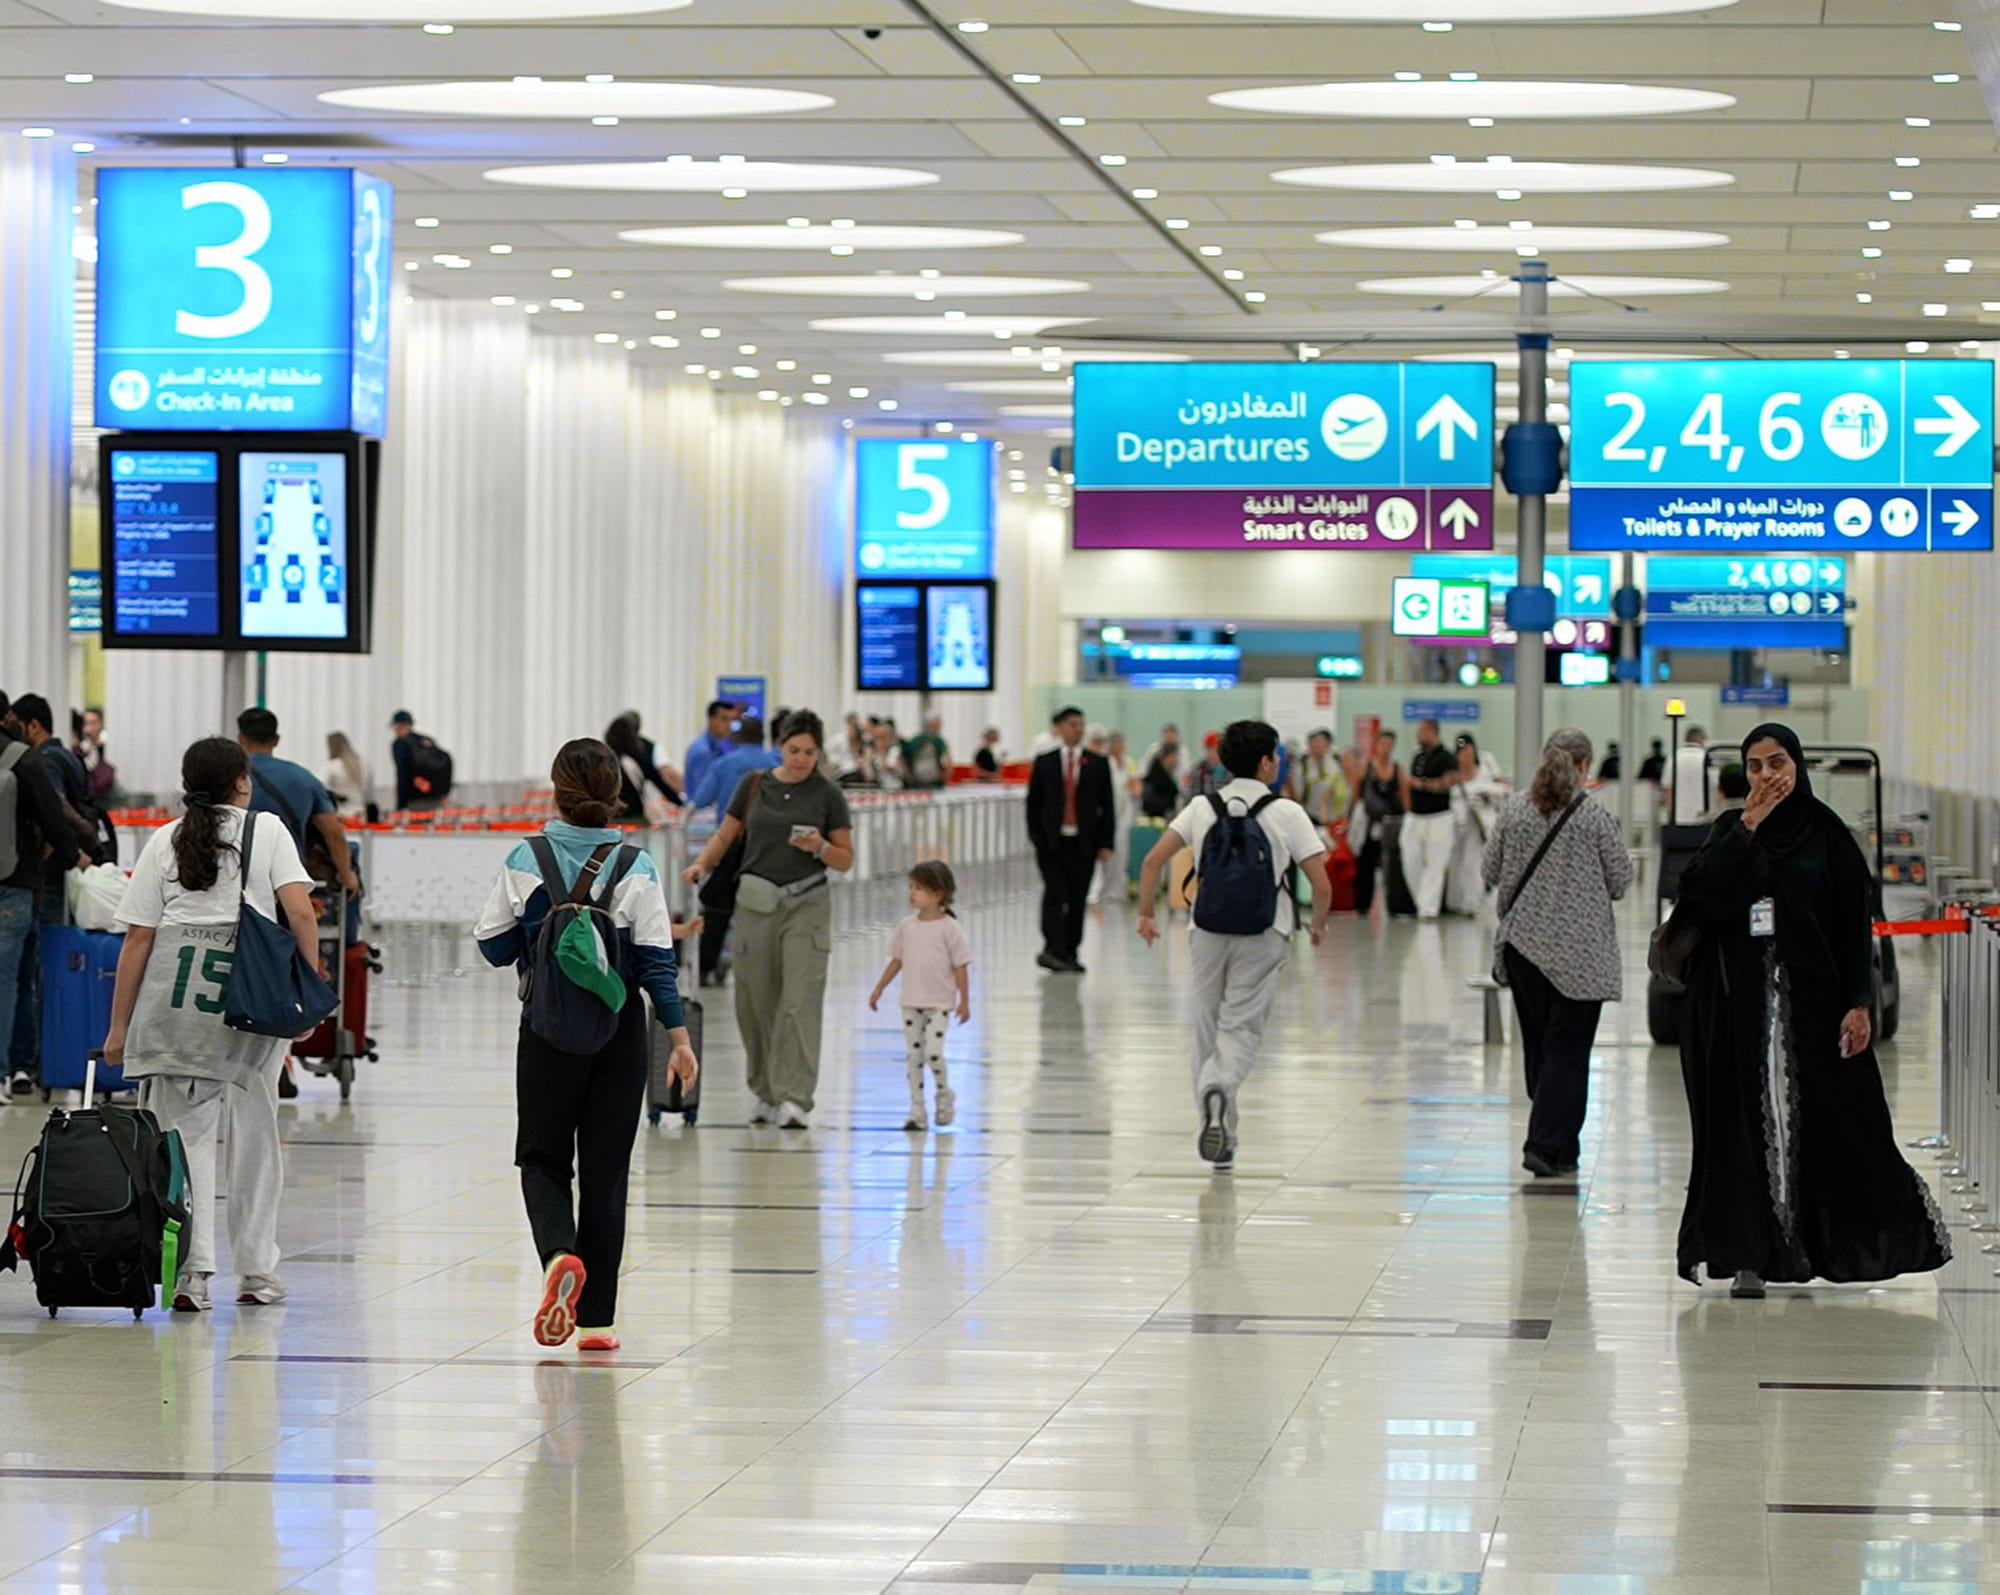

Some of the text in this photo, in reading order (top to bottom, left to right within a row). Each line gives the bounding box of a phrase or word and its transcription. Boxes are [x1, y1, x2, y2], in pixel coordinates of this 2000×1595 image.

[175, 181, 272, 339] 3
[244, 391, 294, 412] Area
[1178, 391, 1307, 426] المغادرون
[1117, 432, 1310, 470] Departures
[896, 444, 950, 529] 5
[1298, 494, 1368, 517] البوابات
[1243, 519, 1368, 541] Smart Gates
[1622, 517, 1825, 541] Toilets & Prayer Rooms
[171, 946, 233, 1014] 15
